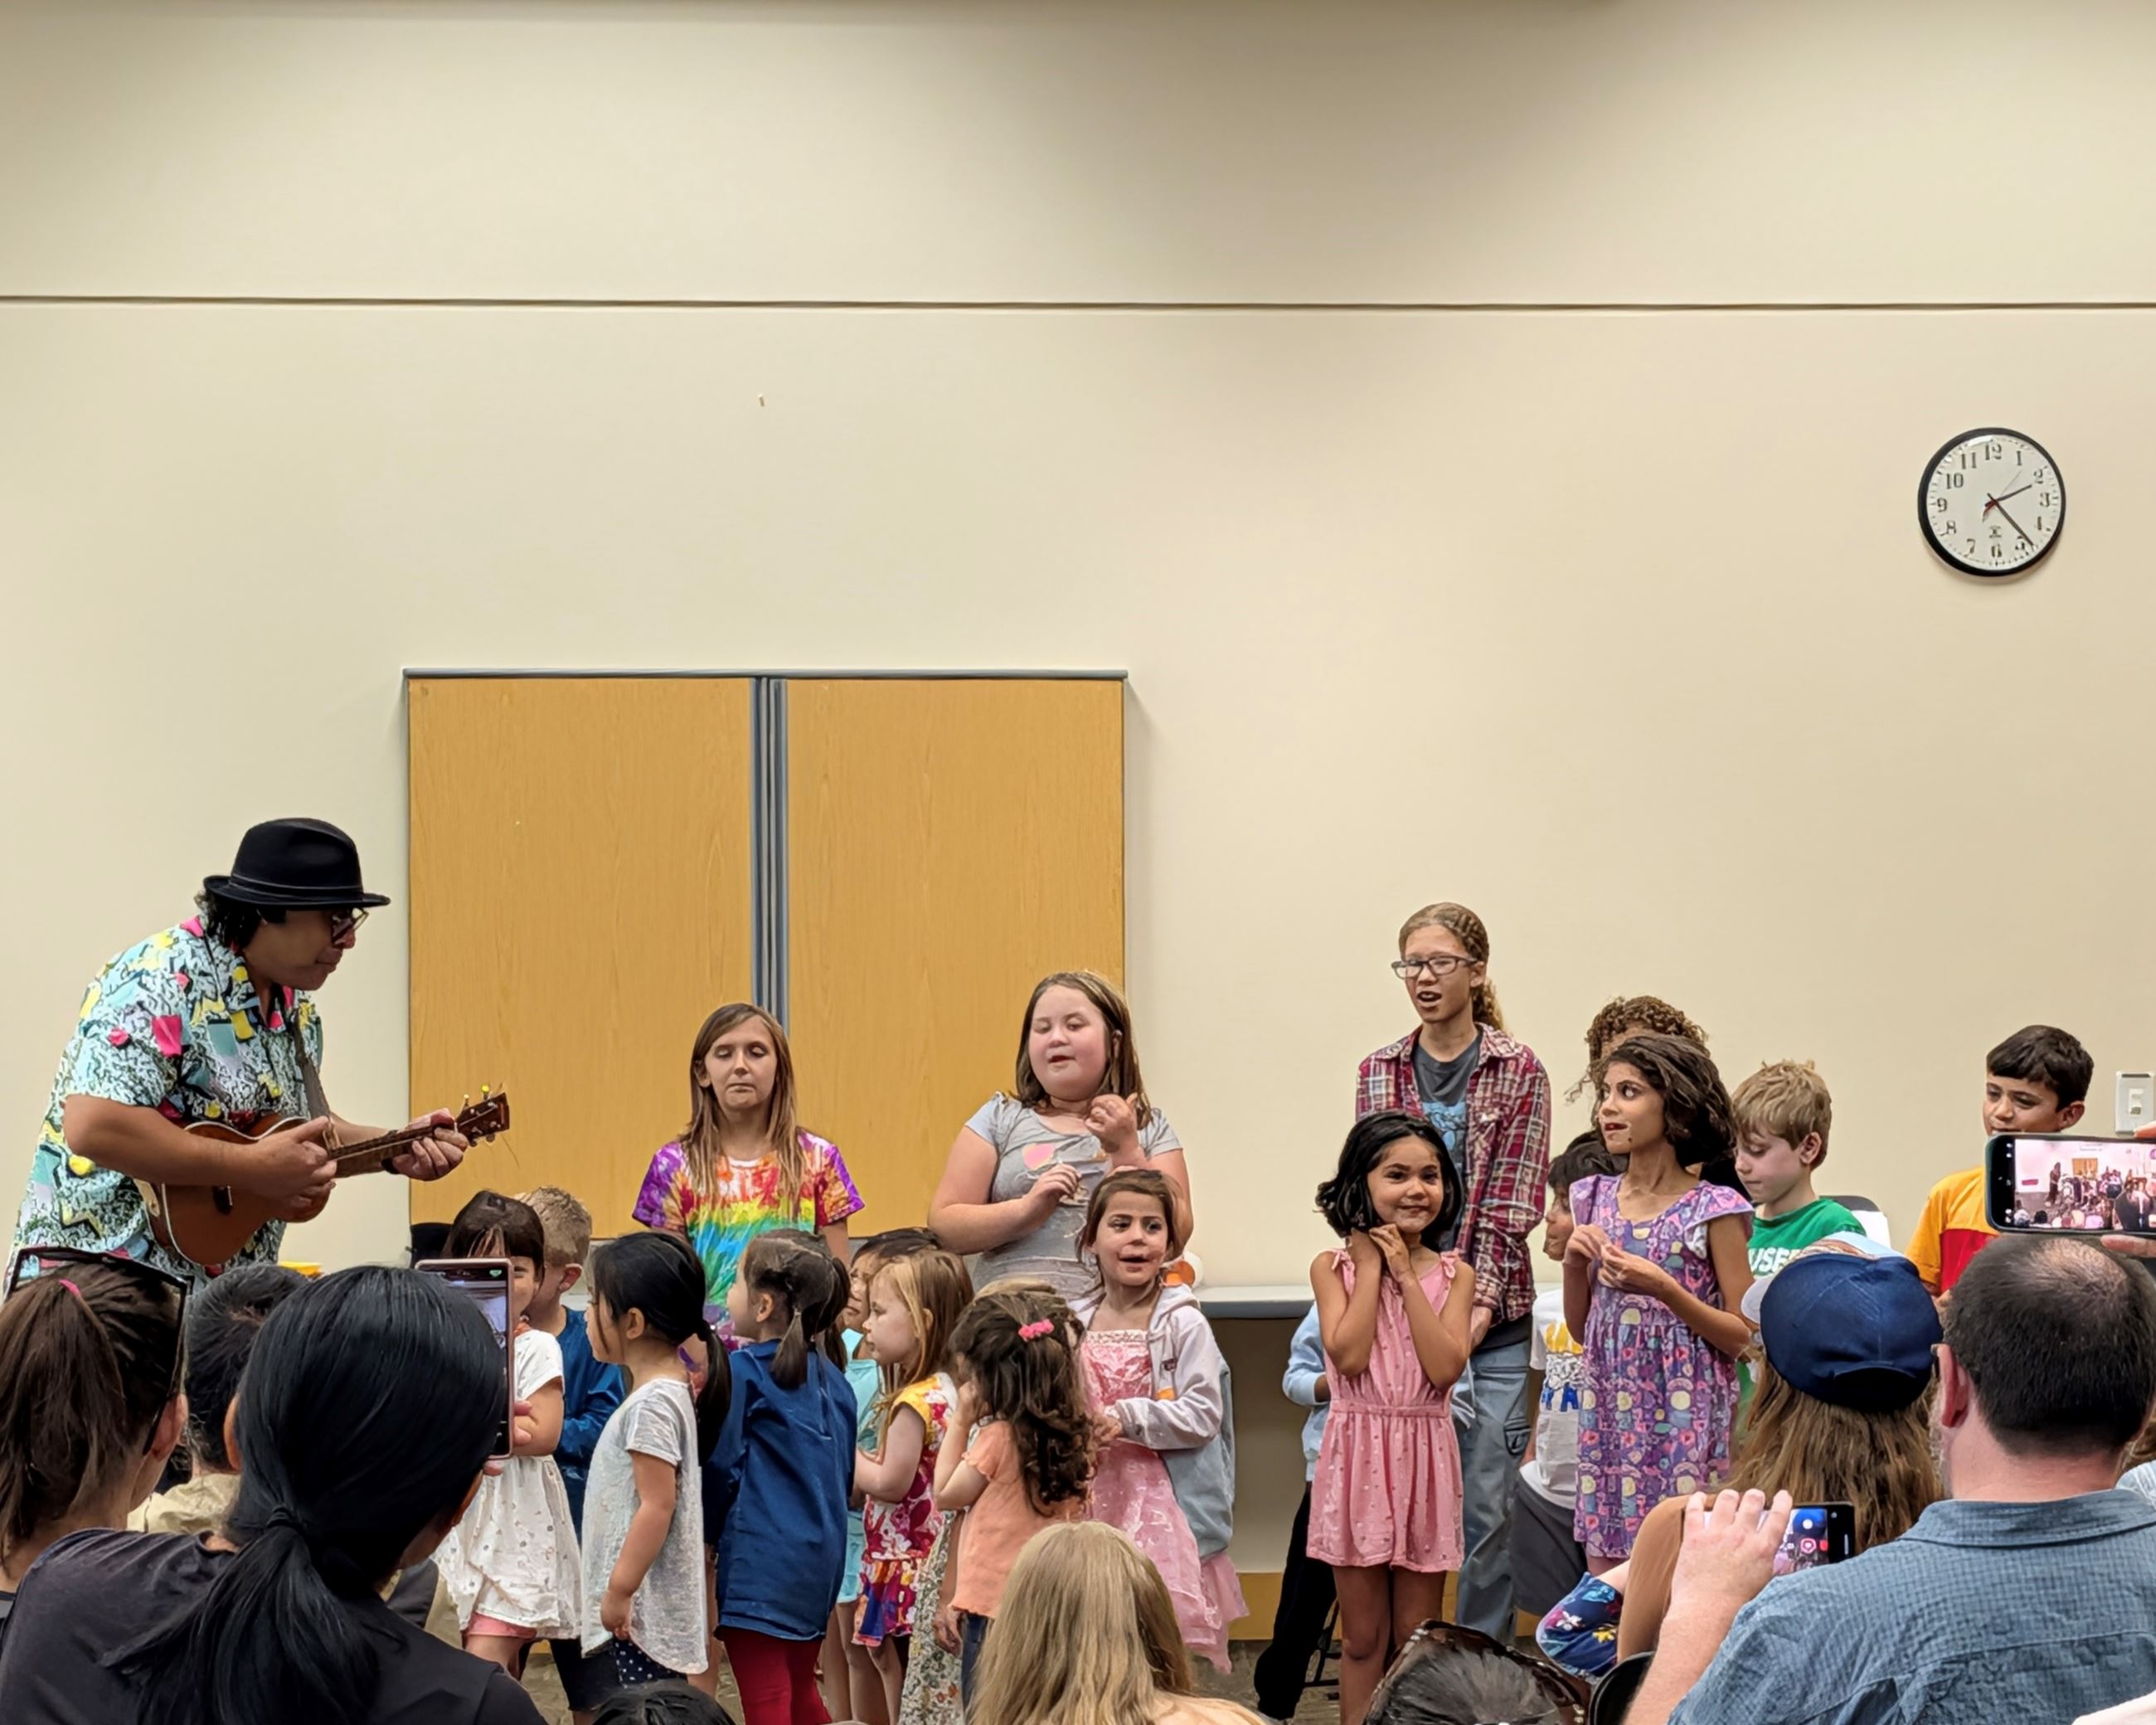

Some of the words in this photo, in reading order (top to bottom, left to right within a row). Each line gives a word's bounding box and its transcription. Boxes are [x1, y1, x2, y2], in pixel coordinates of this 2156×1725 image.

[1985, 444, 2002, 460] 12
[2017, 450, 2022, 466] 1
[1961, 452, 1977, 469] 11
[1946, 473, 1964, 489] 10
[2033, 469, 2043, 484] 2
[1966, 538, 1976, 555] 7
[1748, 1247, 1802, 1272] USE
